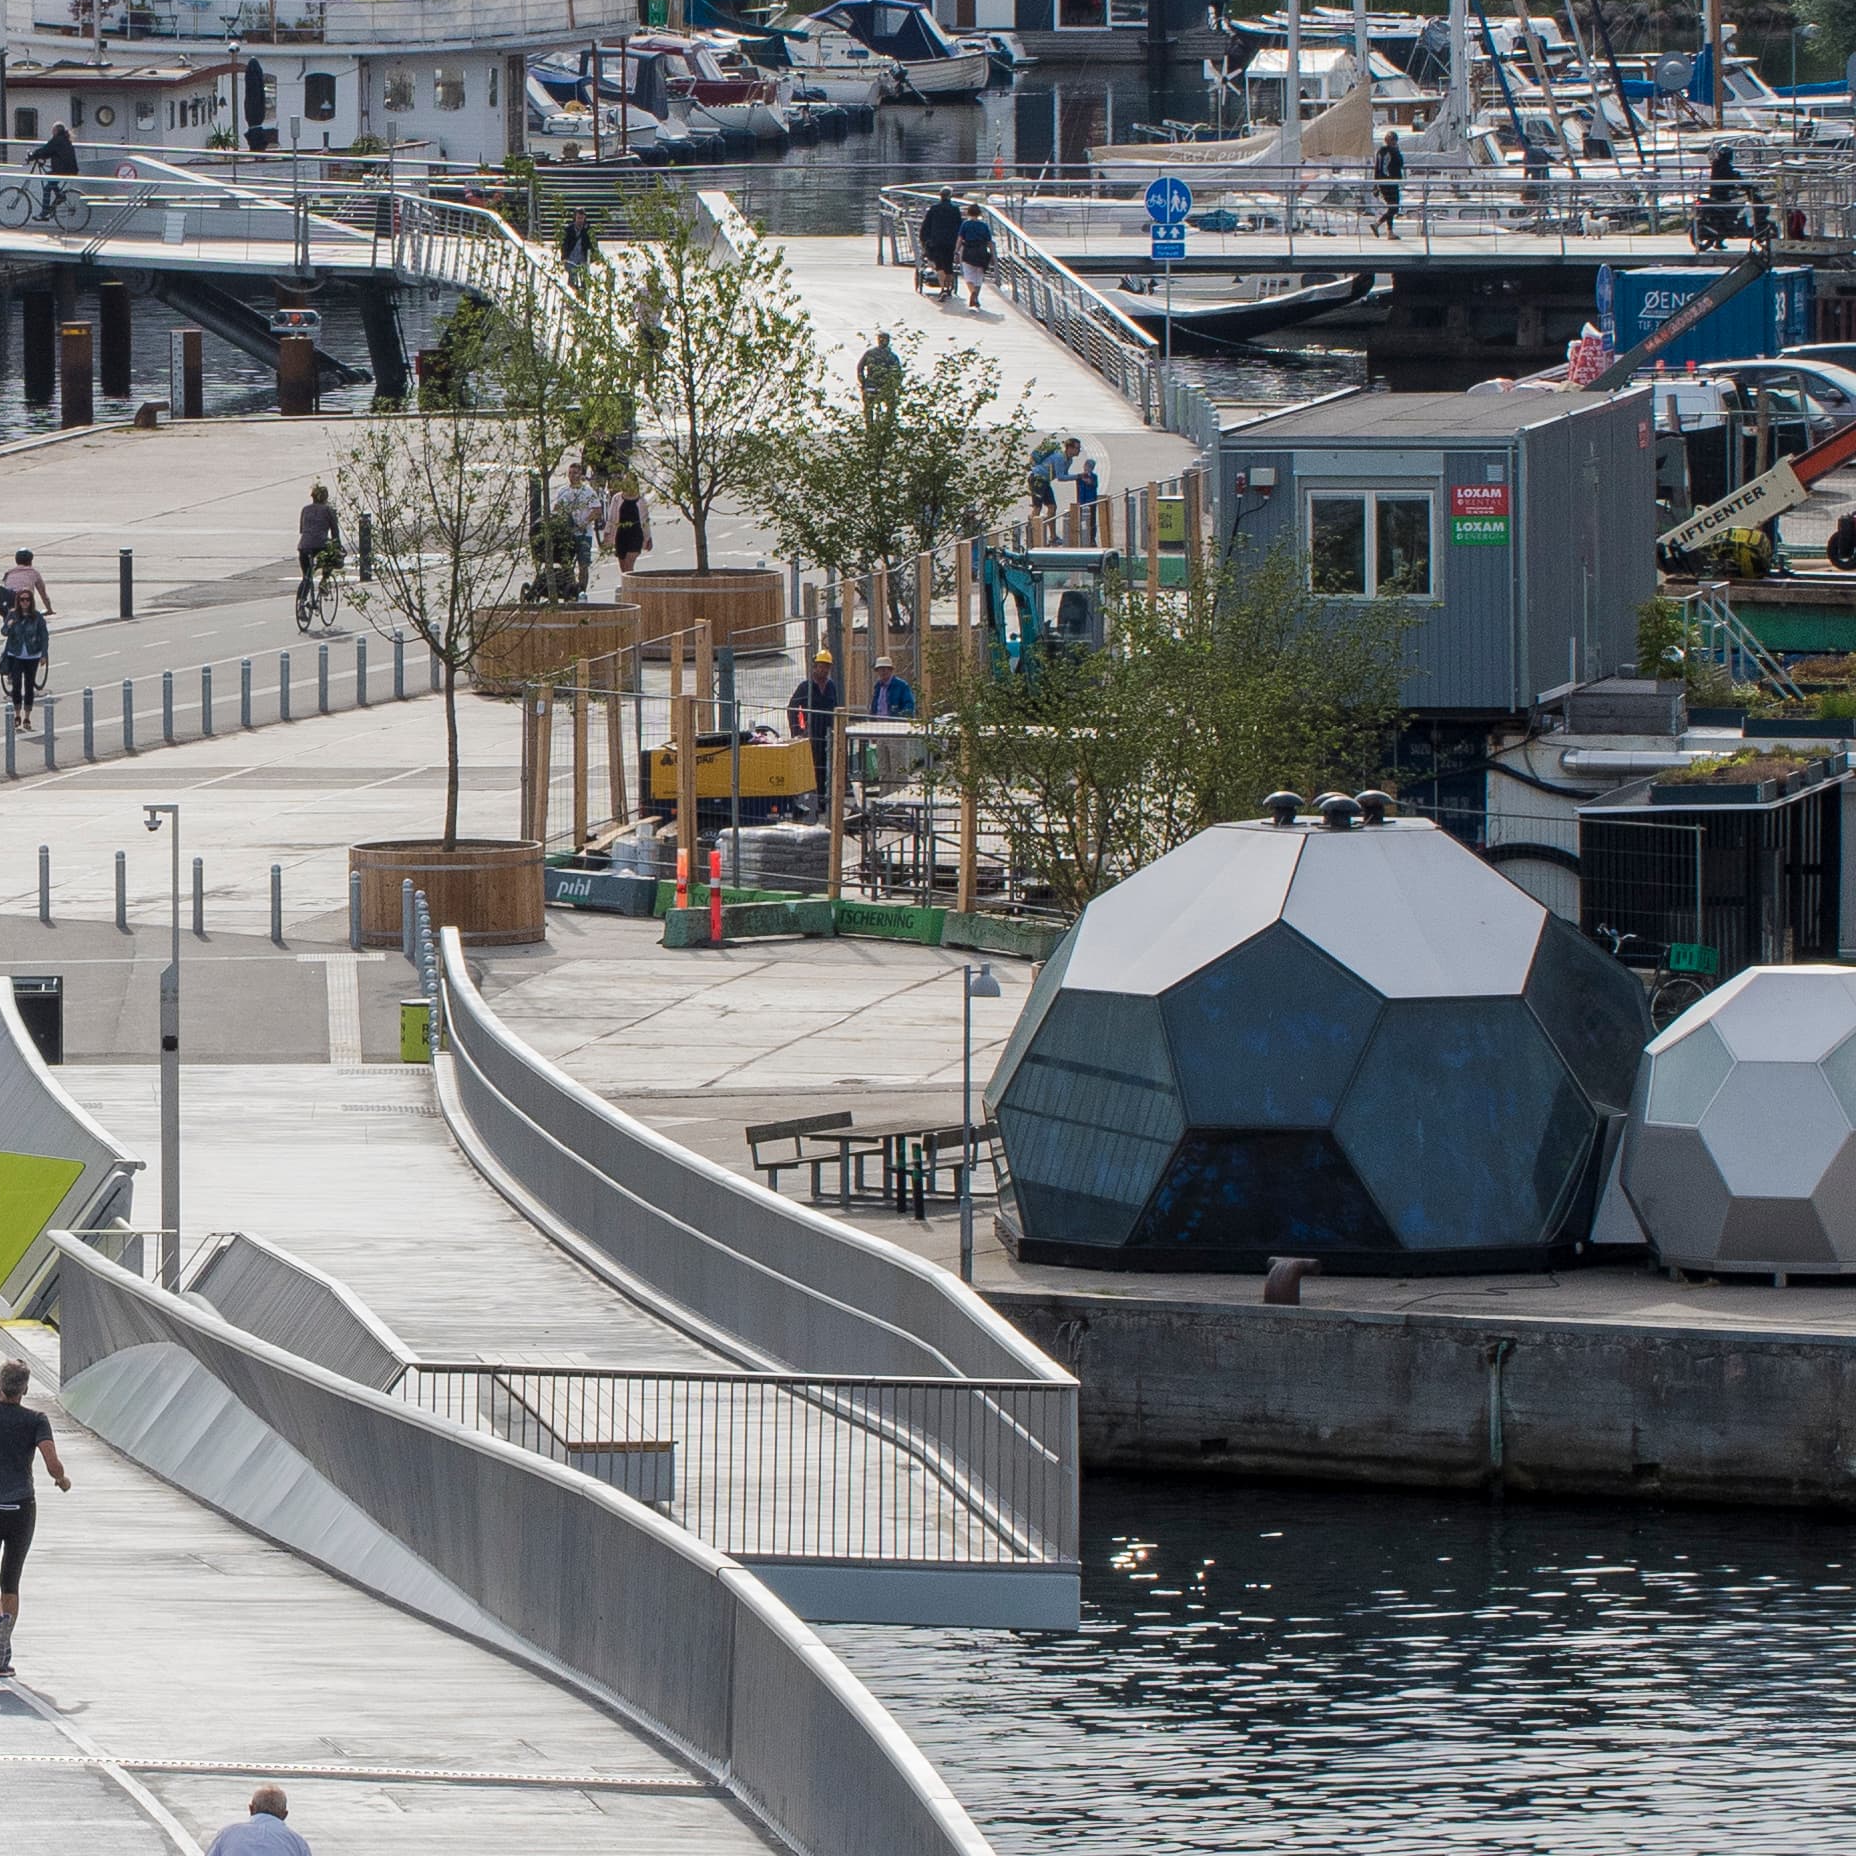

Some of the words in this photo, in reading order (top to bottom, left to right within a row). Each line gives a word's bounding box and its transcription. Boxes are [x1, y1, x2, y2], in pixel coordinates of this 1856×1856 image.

[1457, 488, 1503, 498] LOXAM
[1456, 521, 1505, 532] LOXAM
[1674, 485, 1766, 547] LIFTCENTER
[556, 877, 592, 898] pihl
[838, 908, 915, 930] TSCHERNING
